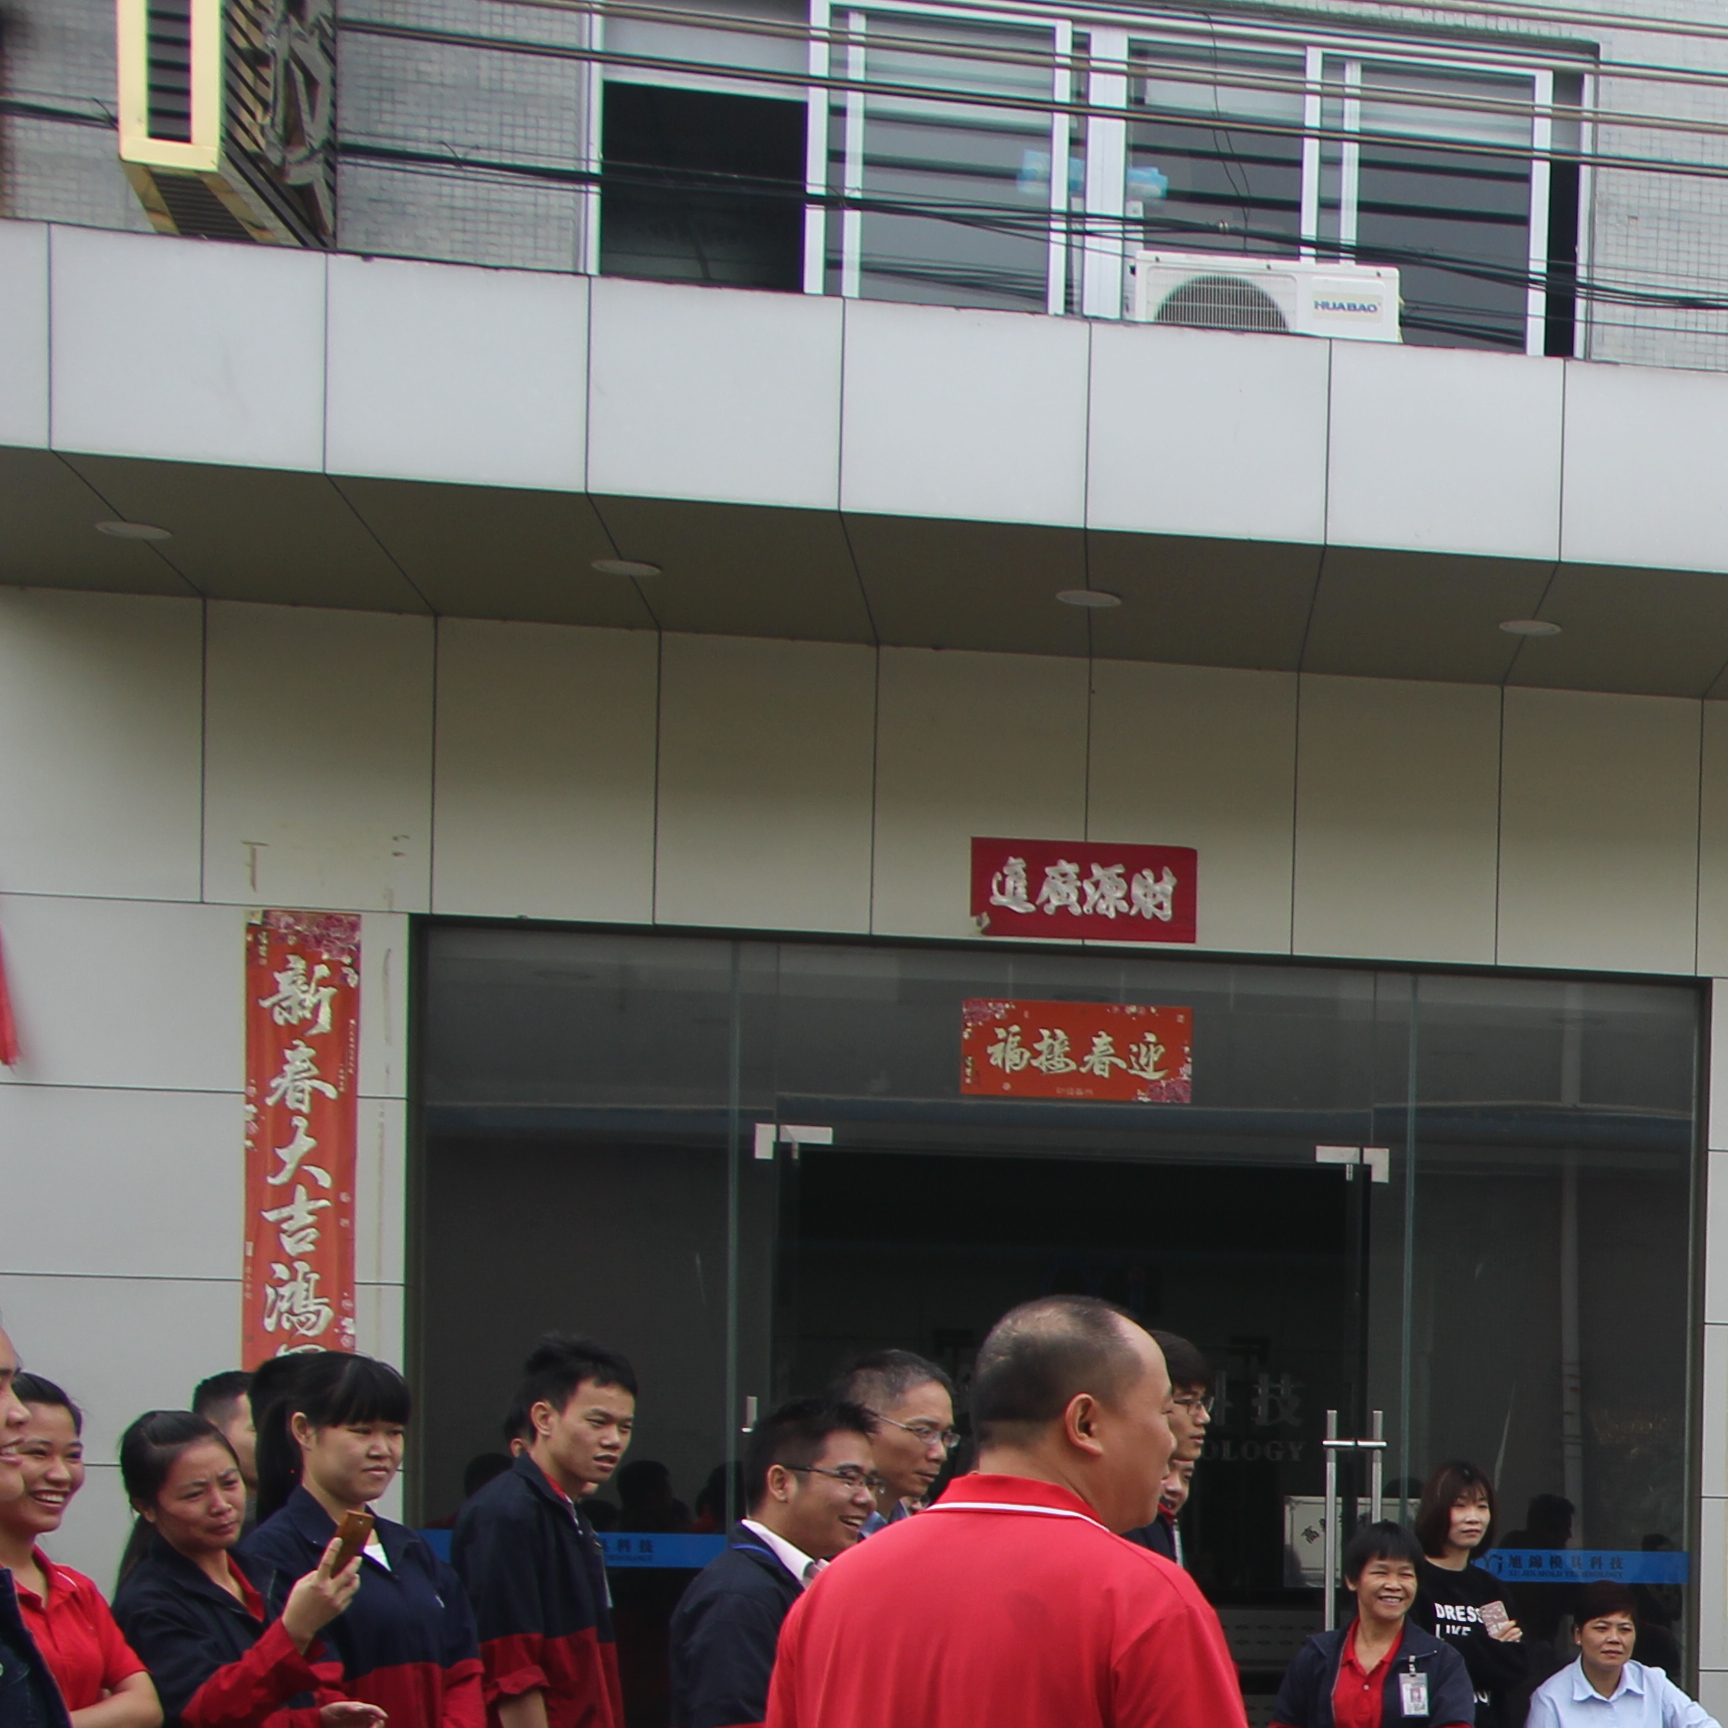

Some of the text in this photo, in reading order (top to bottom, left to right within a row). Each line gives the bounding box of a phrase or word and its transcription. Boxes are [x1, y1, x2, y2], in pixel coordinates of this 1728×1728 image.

[1314, 301, 1379, 313] HUABAO
[257, 953, 339, 1356] 新春大吉鴻
